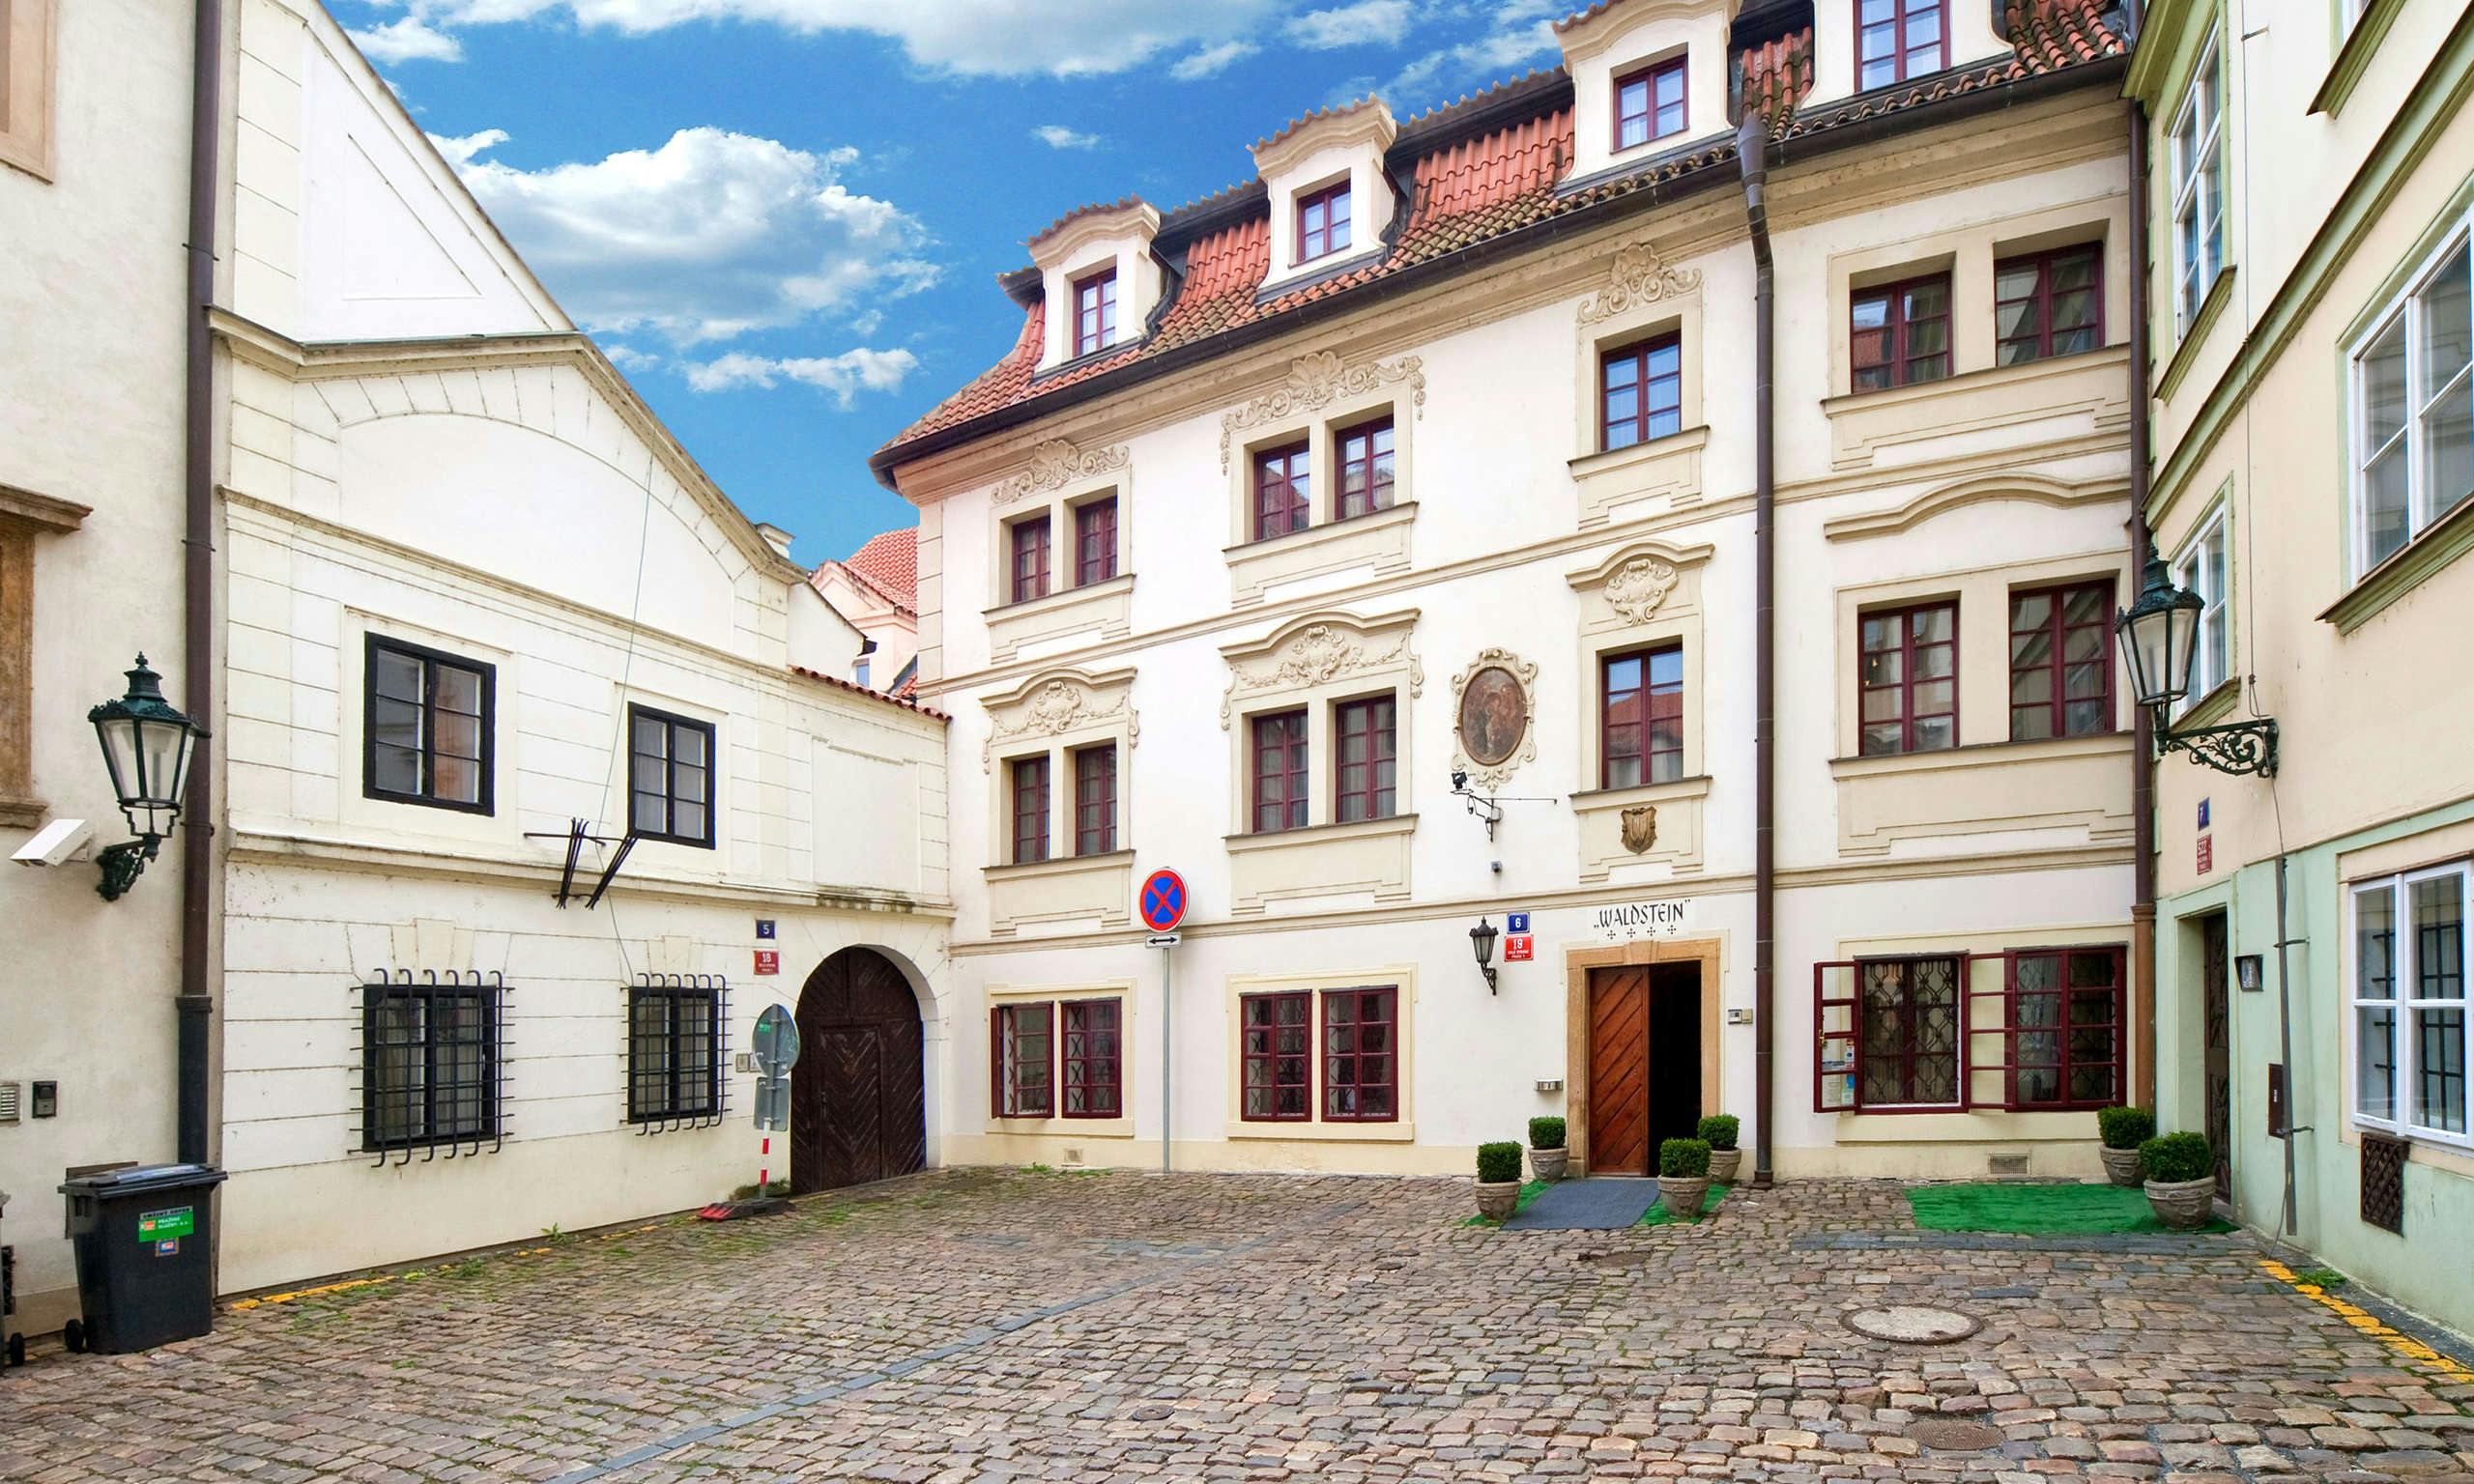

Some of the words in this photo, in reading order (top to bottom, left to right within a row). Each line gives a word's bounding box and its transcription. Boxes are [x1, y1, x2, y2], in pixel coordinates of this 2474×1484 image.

[1515, 917, 1521, 928] 6
[763, 925, 769, 934] 5
[1513, 938, 1523, 950] 19
[762, 953, 771, 962] 18
